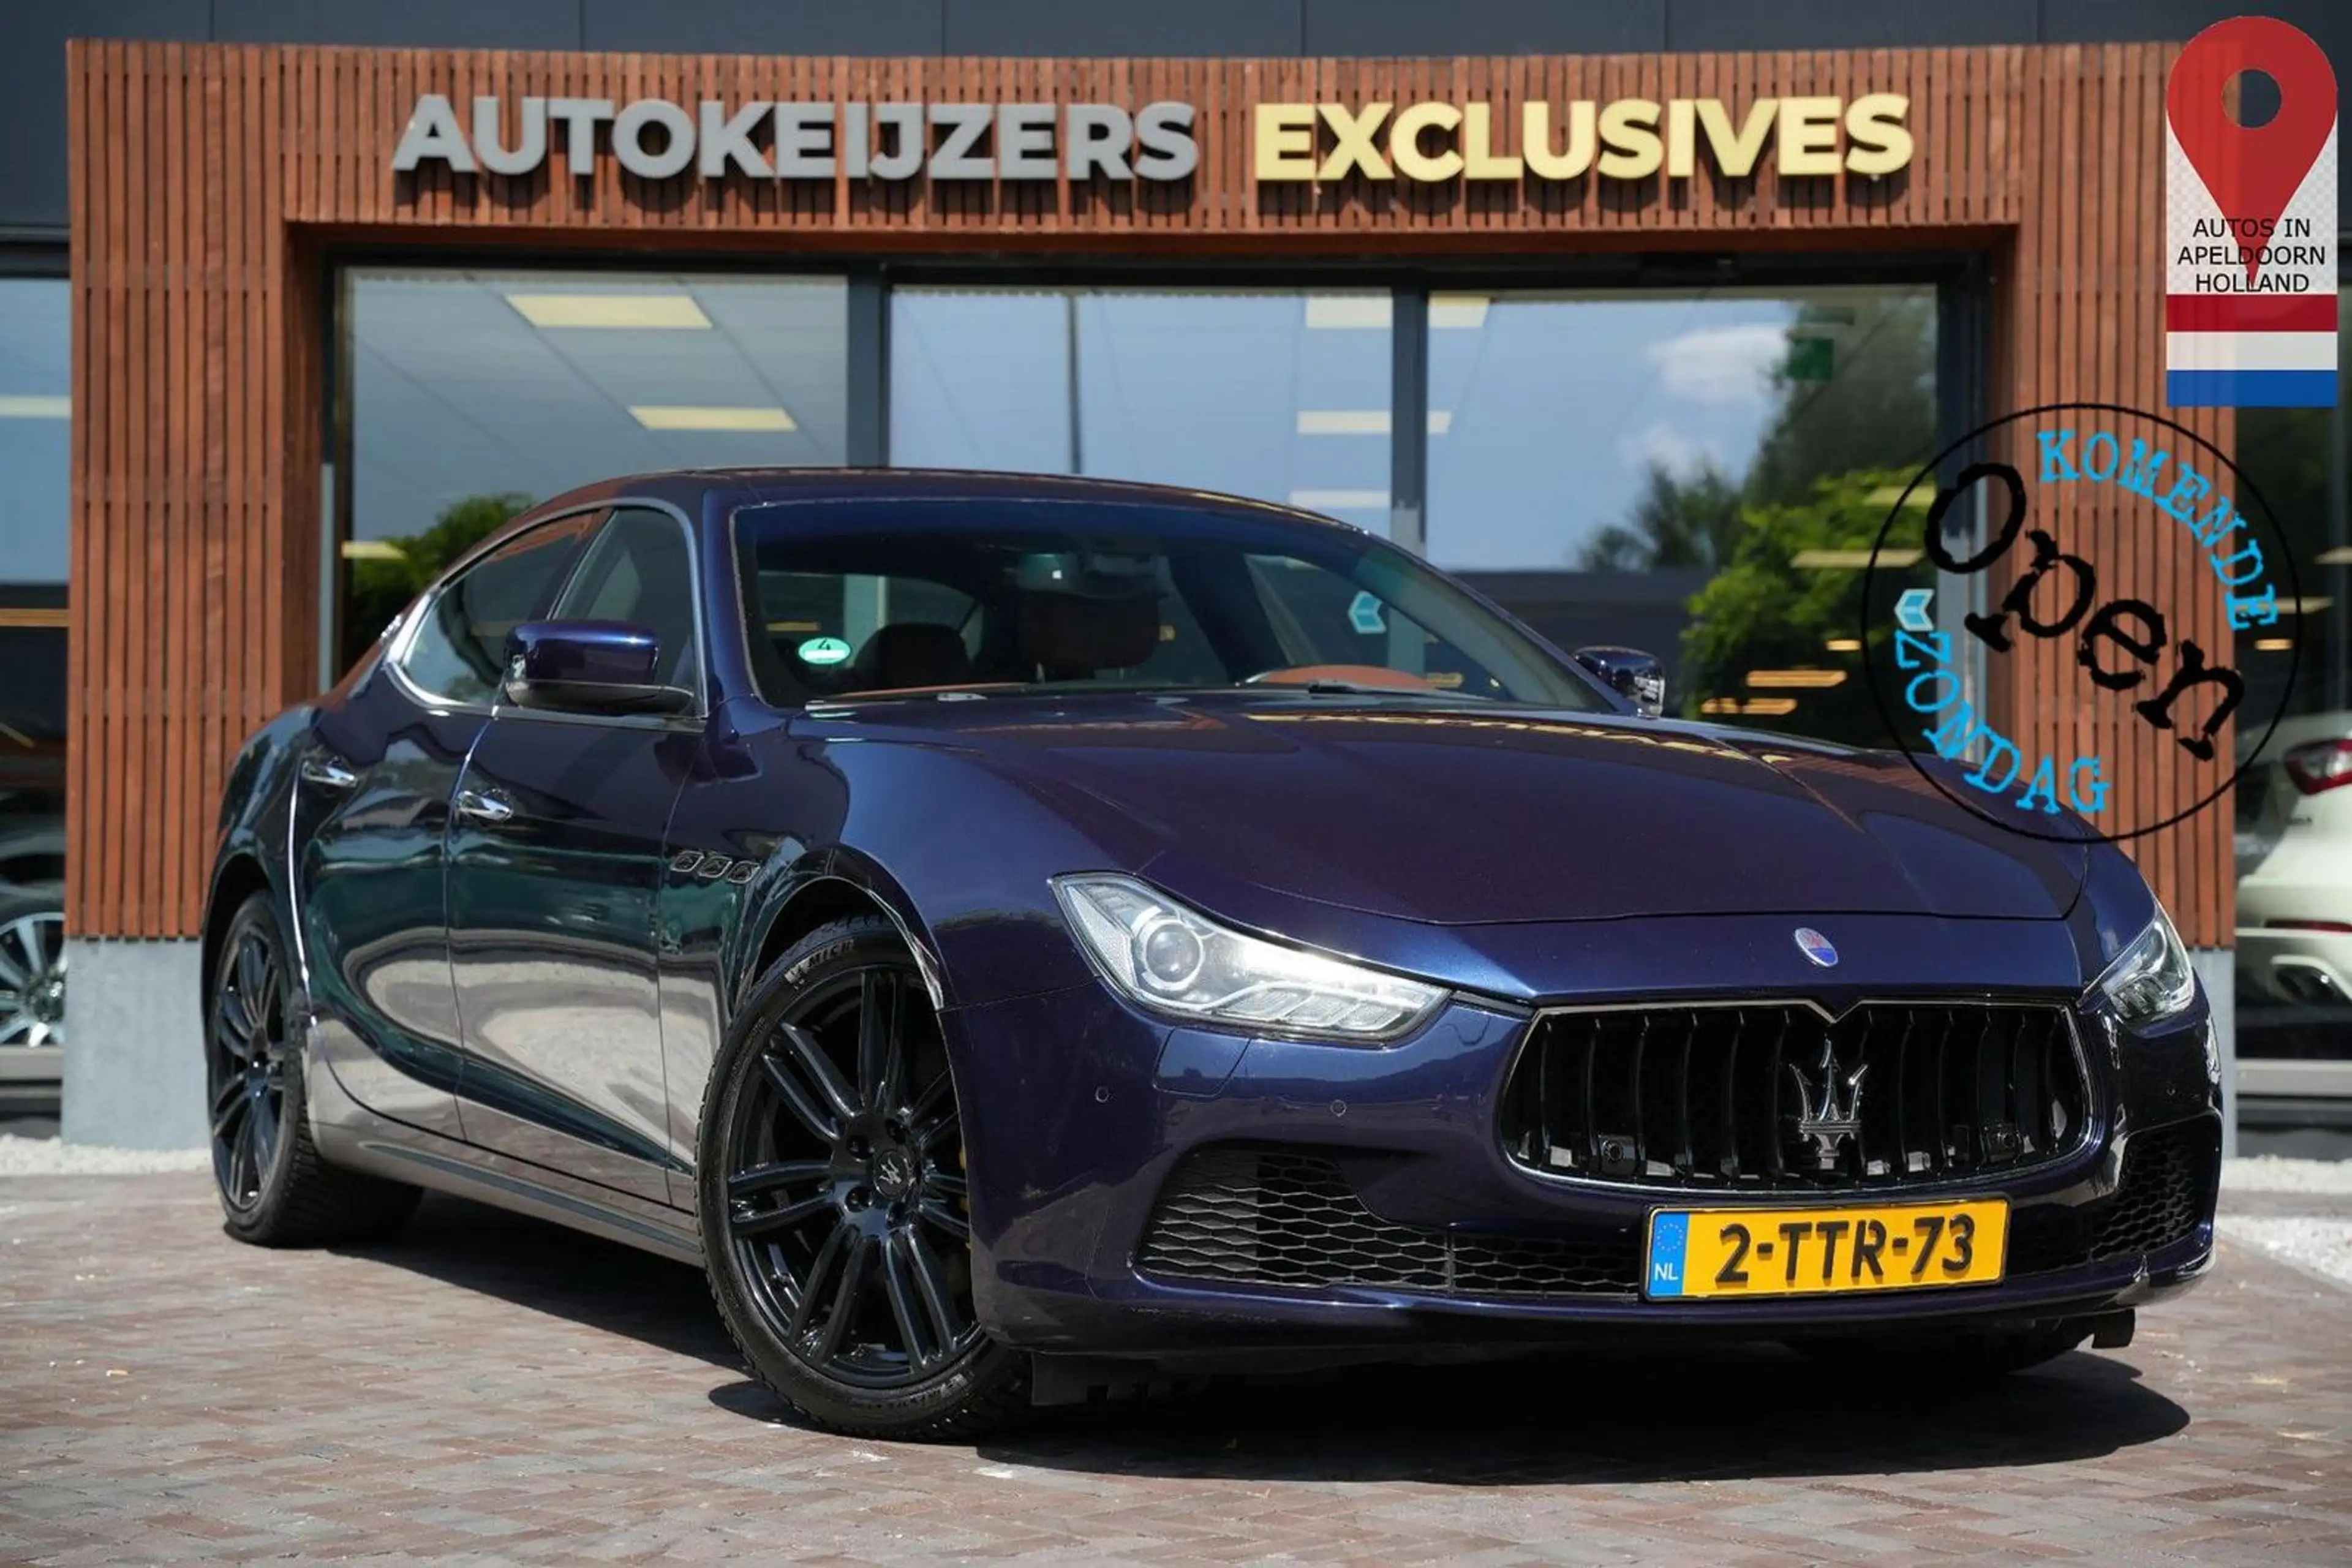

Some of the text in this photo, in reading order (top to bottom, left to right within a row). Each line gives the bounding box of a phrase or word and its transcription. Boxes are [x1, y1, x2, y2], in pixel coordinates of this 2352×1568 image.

[392, 93, 1914, 182] AUTOKEIJZERS EXCLUSIVES
[1654, 1264, 1679, 1281] NL
[1715, 1212, 1976, 1284] 2-TTR-73
